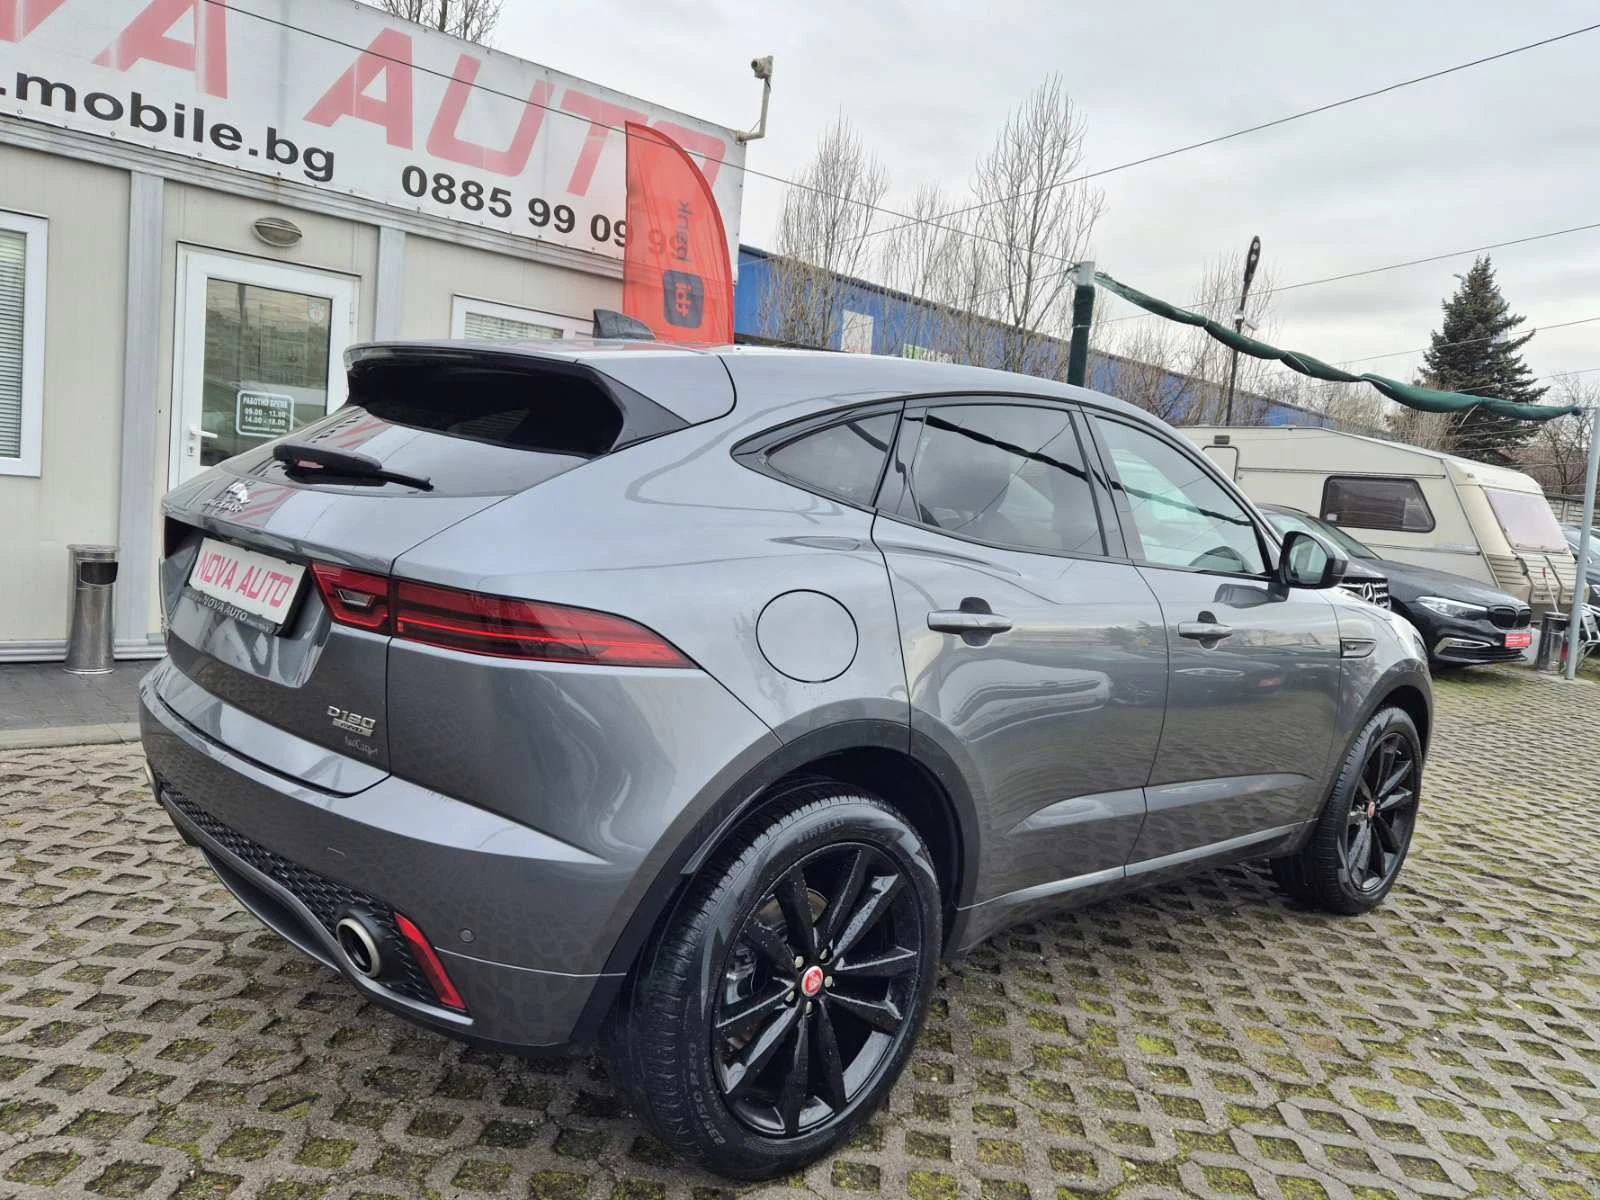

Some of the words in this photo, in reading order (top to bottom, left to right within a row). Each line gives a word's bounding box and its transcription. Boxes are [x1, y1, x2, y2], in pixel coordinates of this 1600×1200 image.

[401, 165, 513, 219] 0885
[527, 197, 577, 234] 99
[196, 550, 239, 591] NOVA
[235, 565, 294, 609] AUTO
[224, 605, 248, 621] AUTO
